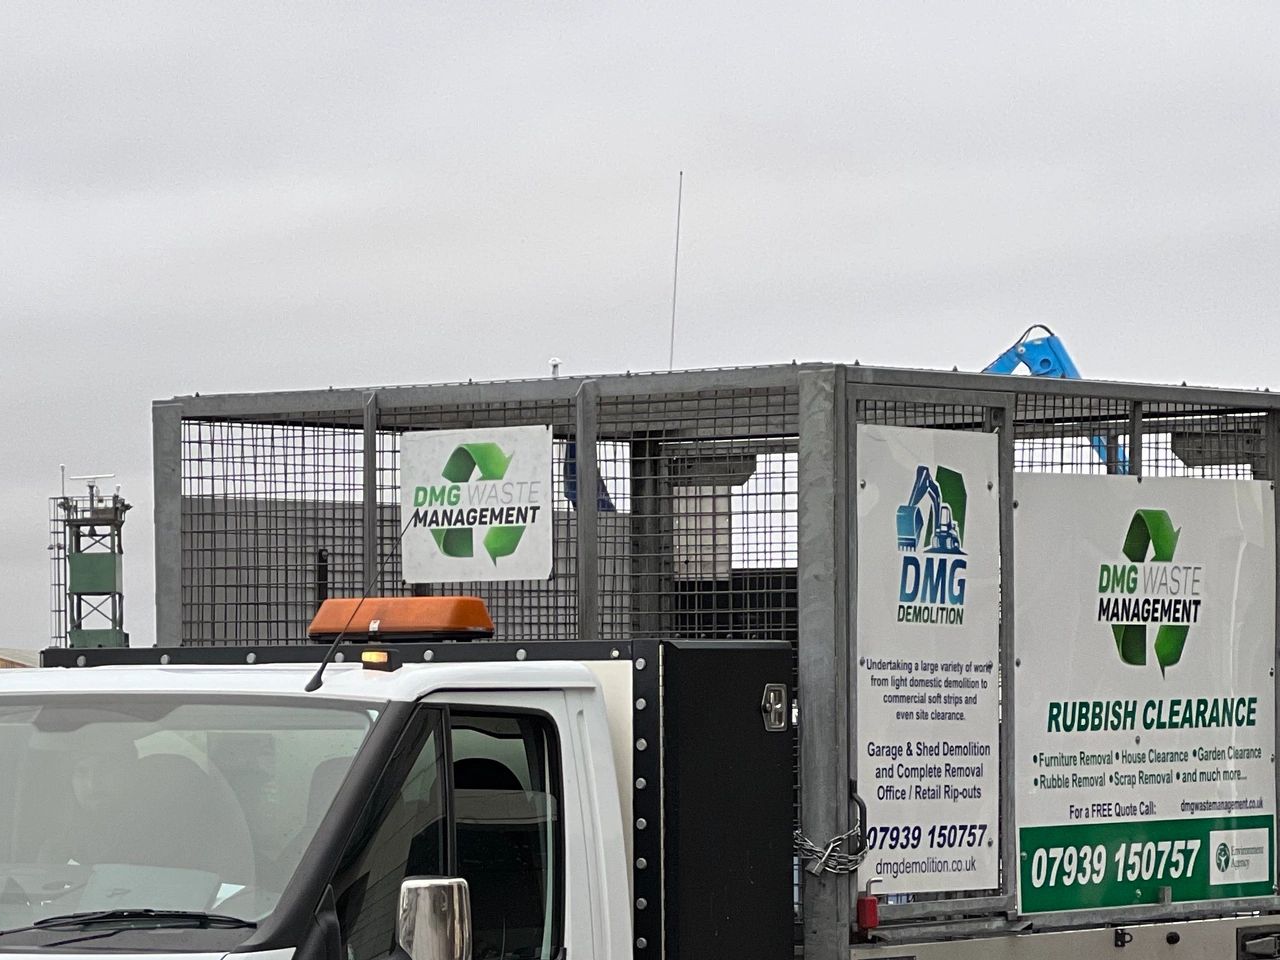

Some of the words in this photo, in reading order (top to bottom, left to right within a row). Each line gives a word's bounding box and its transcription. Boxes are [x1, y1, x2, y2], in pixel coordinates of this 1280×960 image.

[413, 484, 461, 508] DMG
[467, 481, 541, 505] WASTE
[413, 505, 541, 528] MANAGEMENT
[899, 556, 967, 605] DMG
[1098, 564, 1138, 594] DMG
[1143, 566, 1202, 596] WASTE
[897, 605, 964, 625] DEMOLITION
[1097, 598, 1201, 622] MANAGEMENT
[866, 658, 912, 673] Undertaking
[914, 662, 919, 671] a
[921, 660, 938, 674] large
[940, 661, 963, 675] variety
[965, 661, 972, 672] of
[870, 675, 889, 687] from
[891, 675, 907, 689] light
[909, 676, 942, 688] domestic
[944, 678, 979, 689] demolition
[981, 679, 988, 689] to
[883, 693, 926, 704] commercial
[928, 693, 942, 704] soft
[943, 694, 962, 706] strips
[964, 694, 977, 705] and
[896, 711, 914, 720] even
[915, 709, 929, 720] site
[931, 709, 965, 721] clearance.
[1047, 700, 1137, 733] RUBBISH
[1142, 697, 1257, 730] CLEARANCE
[867, 742, 903, 760] Garage
[906, 742, 913, 756] &
[916, 742, 940, 756] Shed
[943, 742, 990, 756] Demolition
[1039, 752, 1077, 767] Furniture
[1079, 750, 1113, 766] Removal
[1121, 749, 1146, 764] House
[1148, 749, 1188, 763] Clearance
[1198, 747, 1226, 761] Garden
[1227, 746, 1262, 760] Clearance
[875, 764, 894, 779] and
[897, 763, 942, 781] Complete
[945, 763, 983, 778] Removal
[1040, 774, 1070, 789] Rubble
[1072, 772, 1106, 788] Removal
[1114, 771, 1136, 788] Scrap
[1138, 769, 1173, 785] Removal
[1182, 768, 1197, 783] and
[1199, 767, 1220, 782] much
[877, 785, 906, 800] Office
[915, 785, 941, 800] Retail
[944, 785, 982, 803] Rip-outs
[1069, 804, 1082, 819] For
[1085, 808, 1089, 818] a
[1091, 803, 1113, 818] FREE
[1114, 802, 1137, 817] Quote
[1139, 801, 1157, 816] Call:
[868, 826, 922, 850] 07939
[928, 824, 987, 848] 150757
[875, 856, 977, 878] dmgdemolition.co.uk
[1031, 844, 1107, 888] 07939
[1114, 839, 1201, 882] 150757
